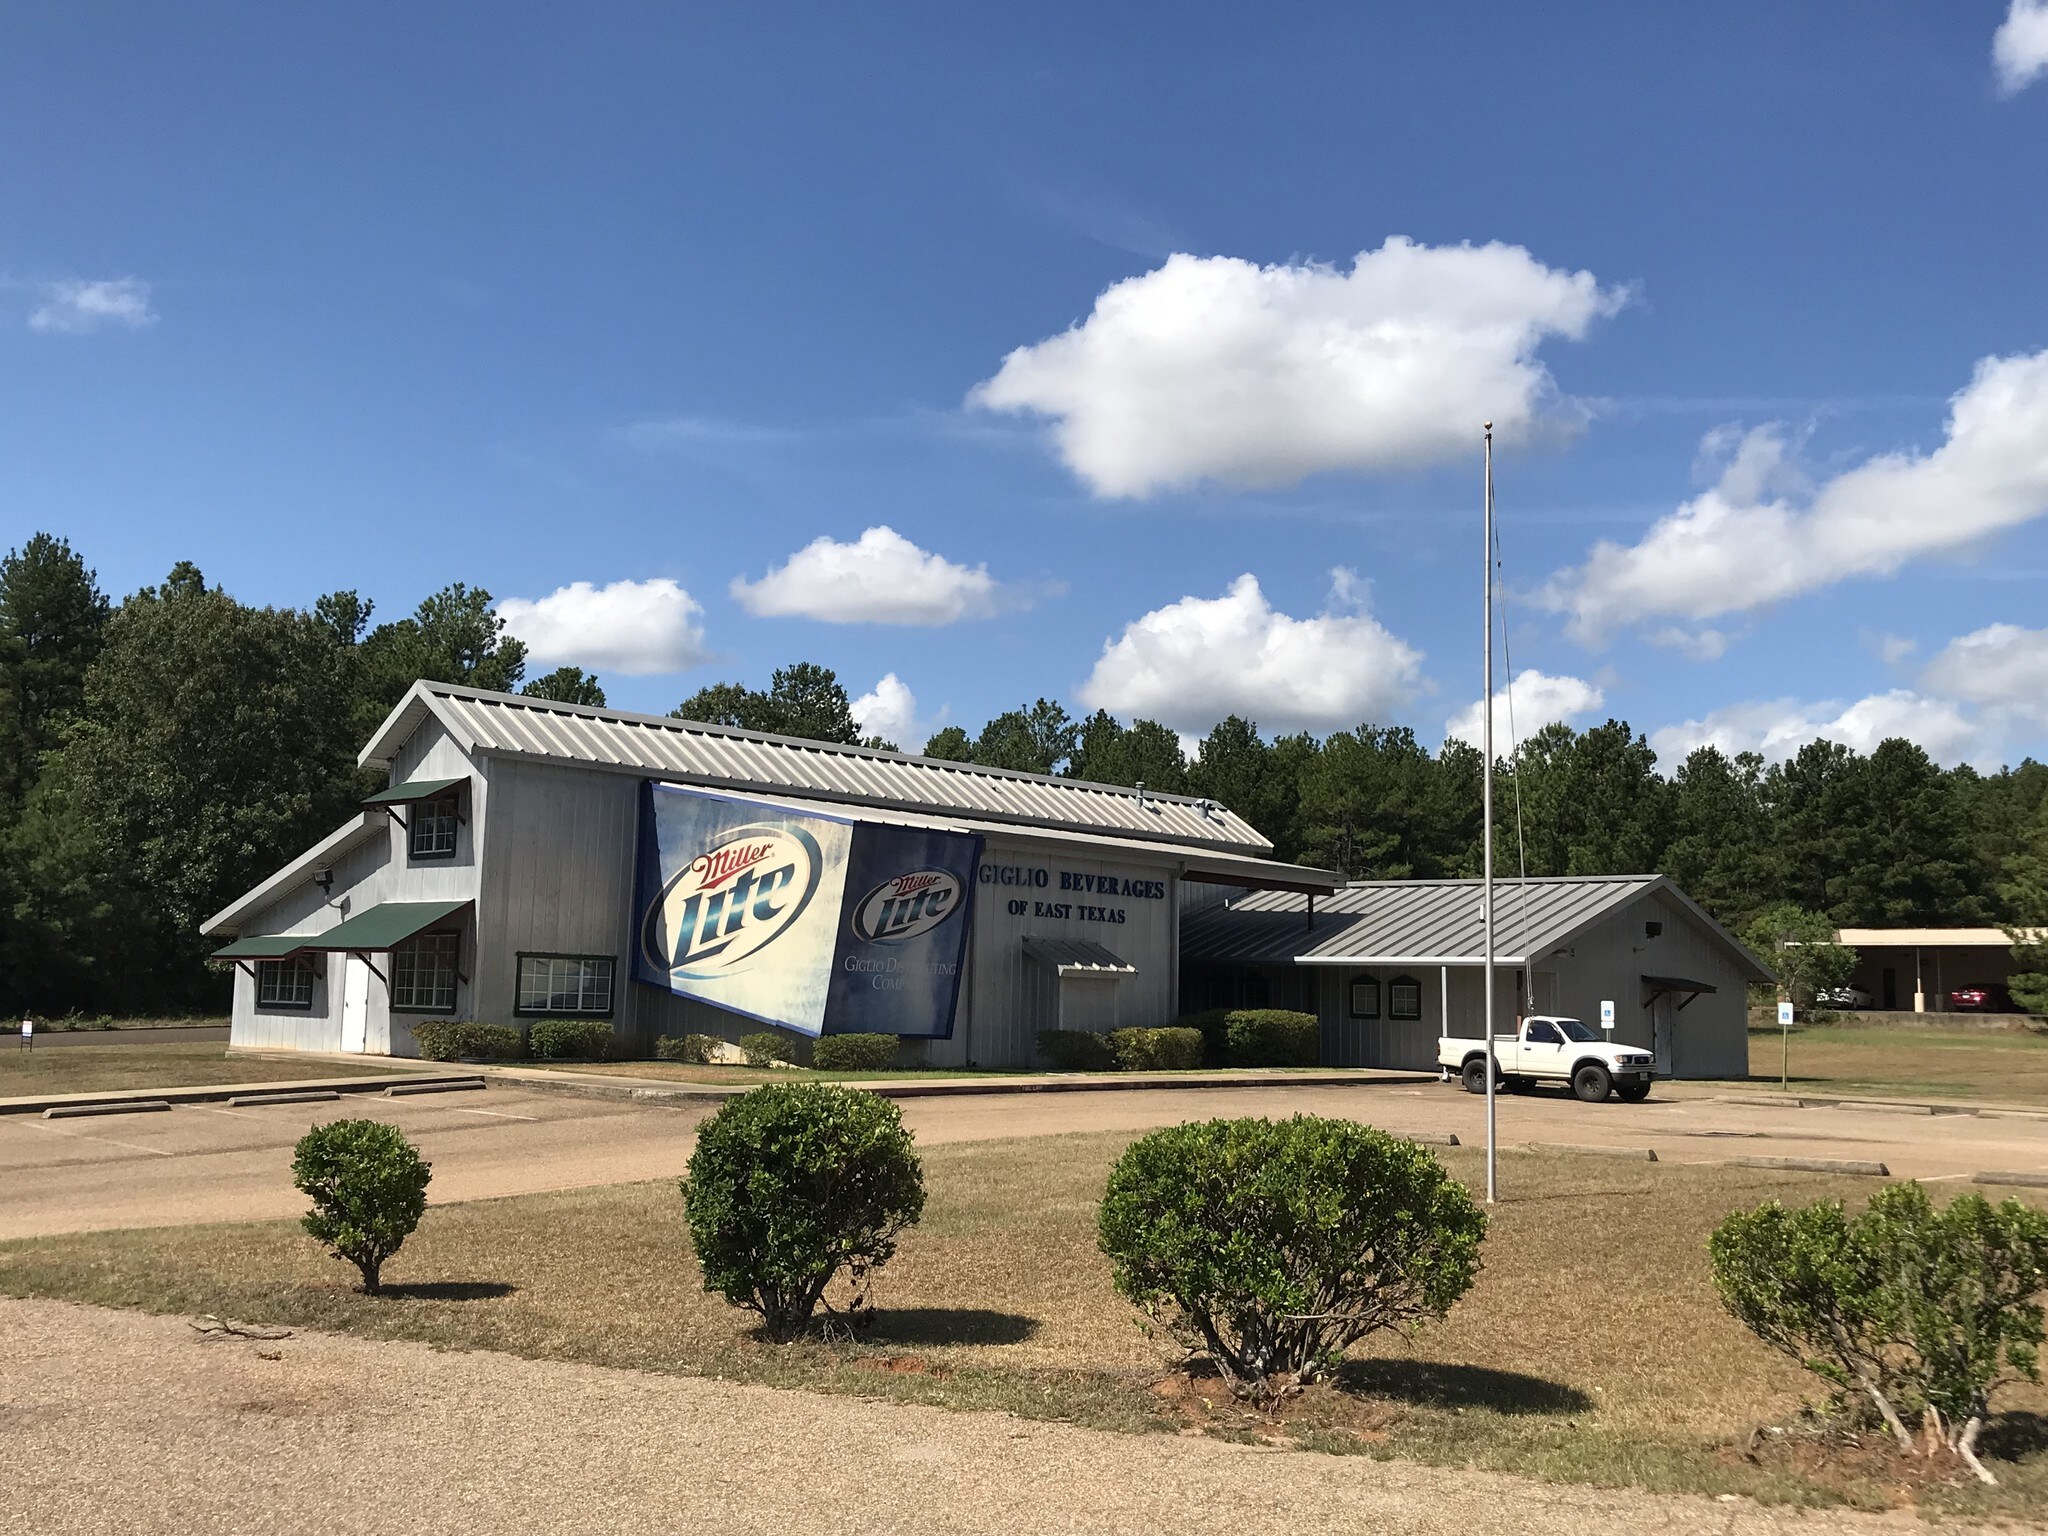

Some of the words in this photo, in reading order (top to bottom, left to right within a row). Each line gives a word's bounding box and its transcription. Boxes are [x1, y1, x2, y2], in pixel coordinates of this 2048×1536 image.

[692, 844, 774, 886] Miller
[889, 875, 941, 894] Miller
[978, 864, 1049, 888] GIGLIO
[1060, 871, 1165, 900] BEVERAGES
[668, 863, 795, 969] Lite
[868, 887, 952, 940] Lite
[1008, 900, 1028, 916] OF
[1034, 902, 1073, 920] EAST
[1078, 905, 1126, 924] TEXAS
